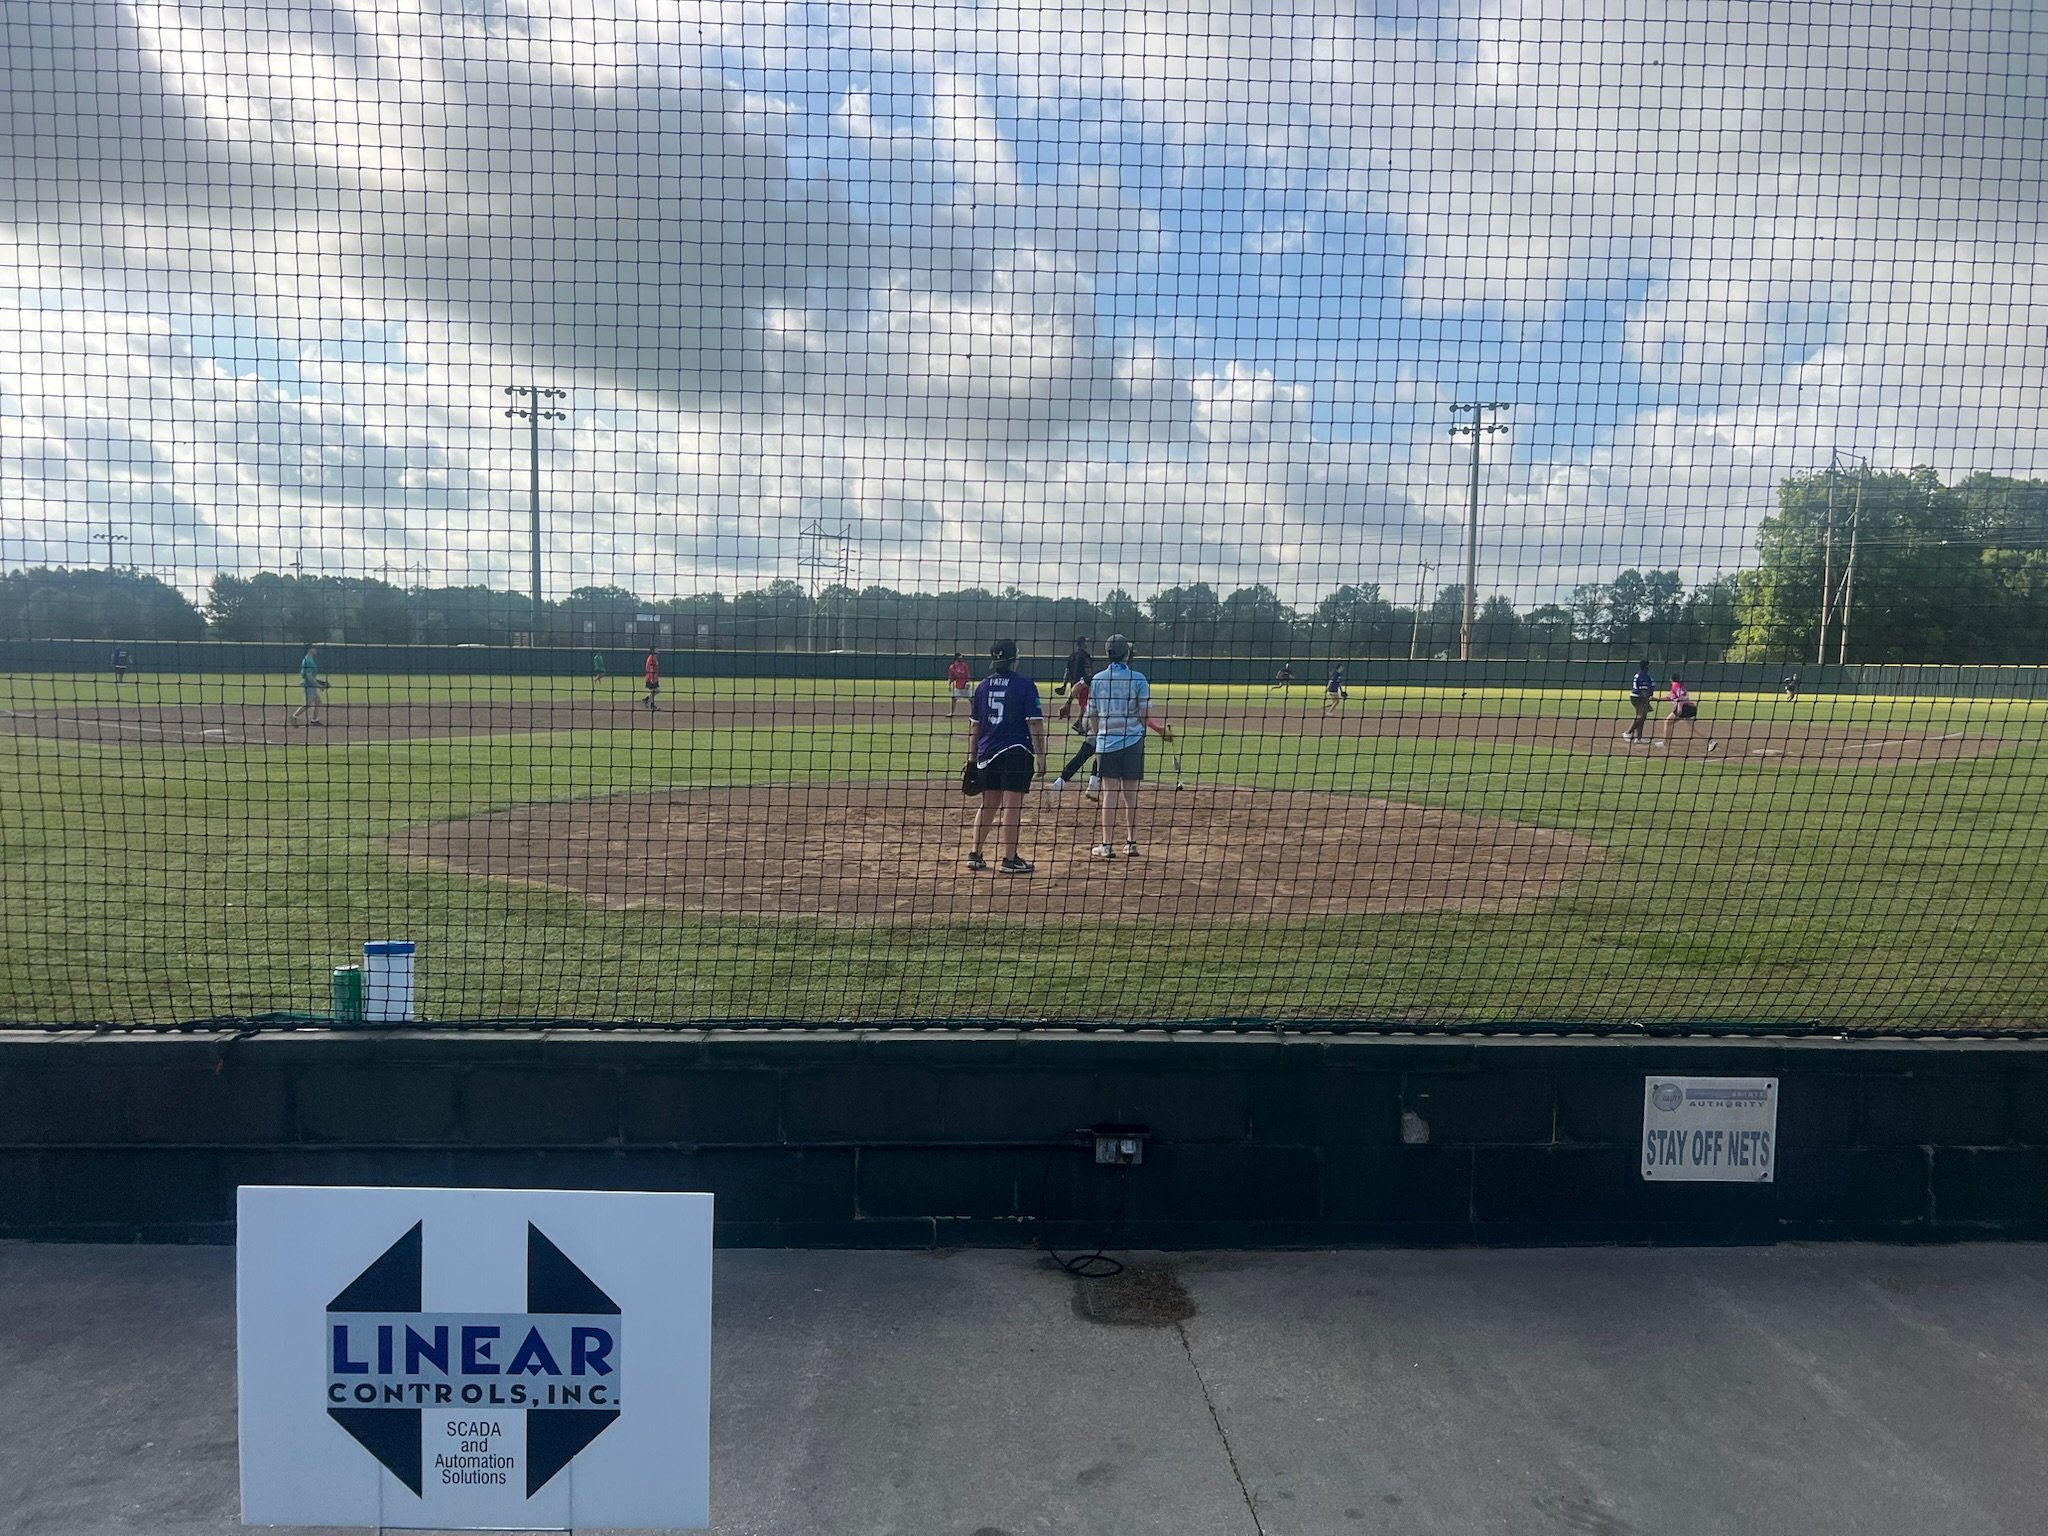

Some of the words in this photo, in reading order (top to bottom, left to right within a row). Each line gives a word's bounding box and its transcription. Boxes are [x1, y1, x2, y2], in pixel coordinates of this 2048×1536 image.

[988, 691, 1005, 725] 5
[1646, 1129, 1688, 1166] STAY
[1692, 1130, 1723, 1166] OFF
[1727, 1131, 1770, 1167] NETS
[333, 1325, 614, 1376] LINEAR
[328, 1382, 539, 1408] CONTROLS,
[547, 1384, 621, 1405] INC.
[446, 1422, 502, 1437] SCADA
[461, 1438, 488, 1453] and
[434, 1454, 515, 1470] Automation
[441, 1469, 507, 1485] Solutions
